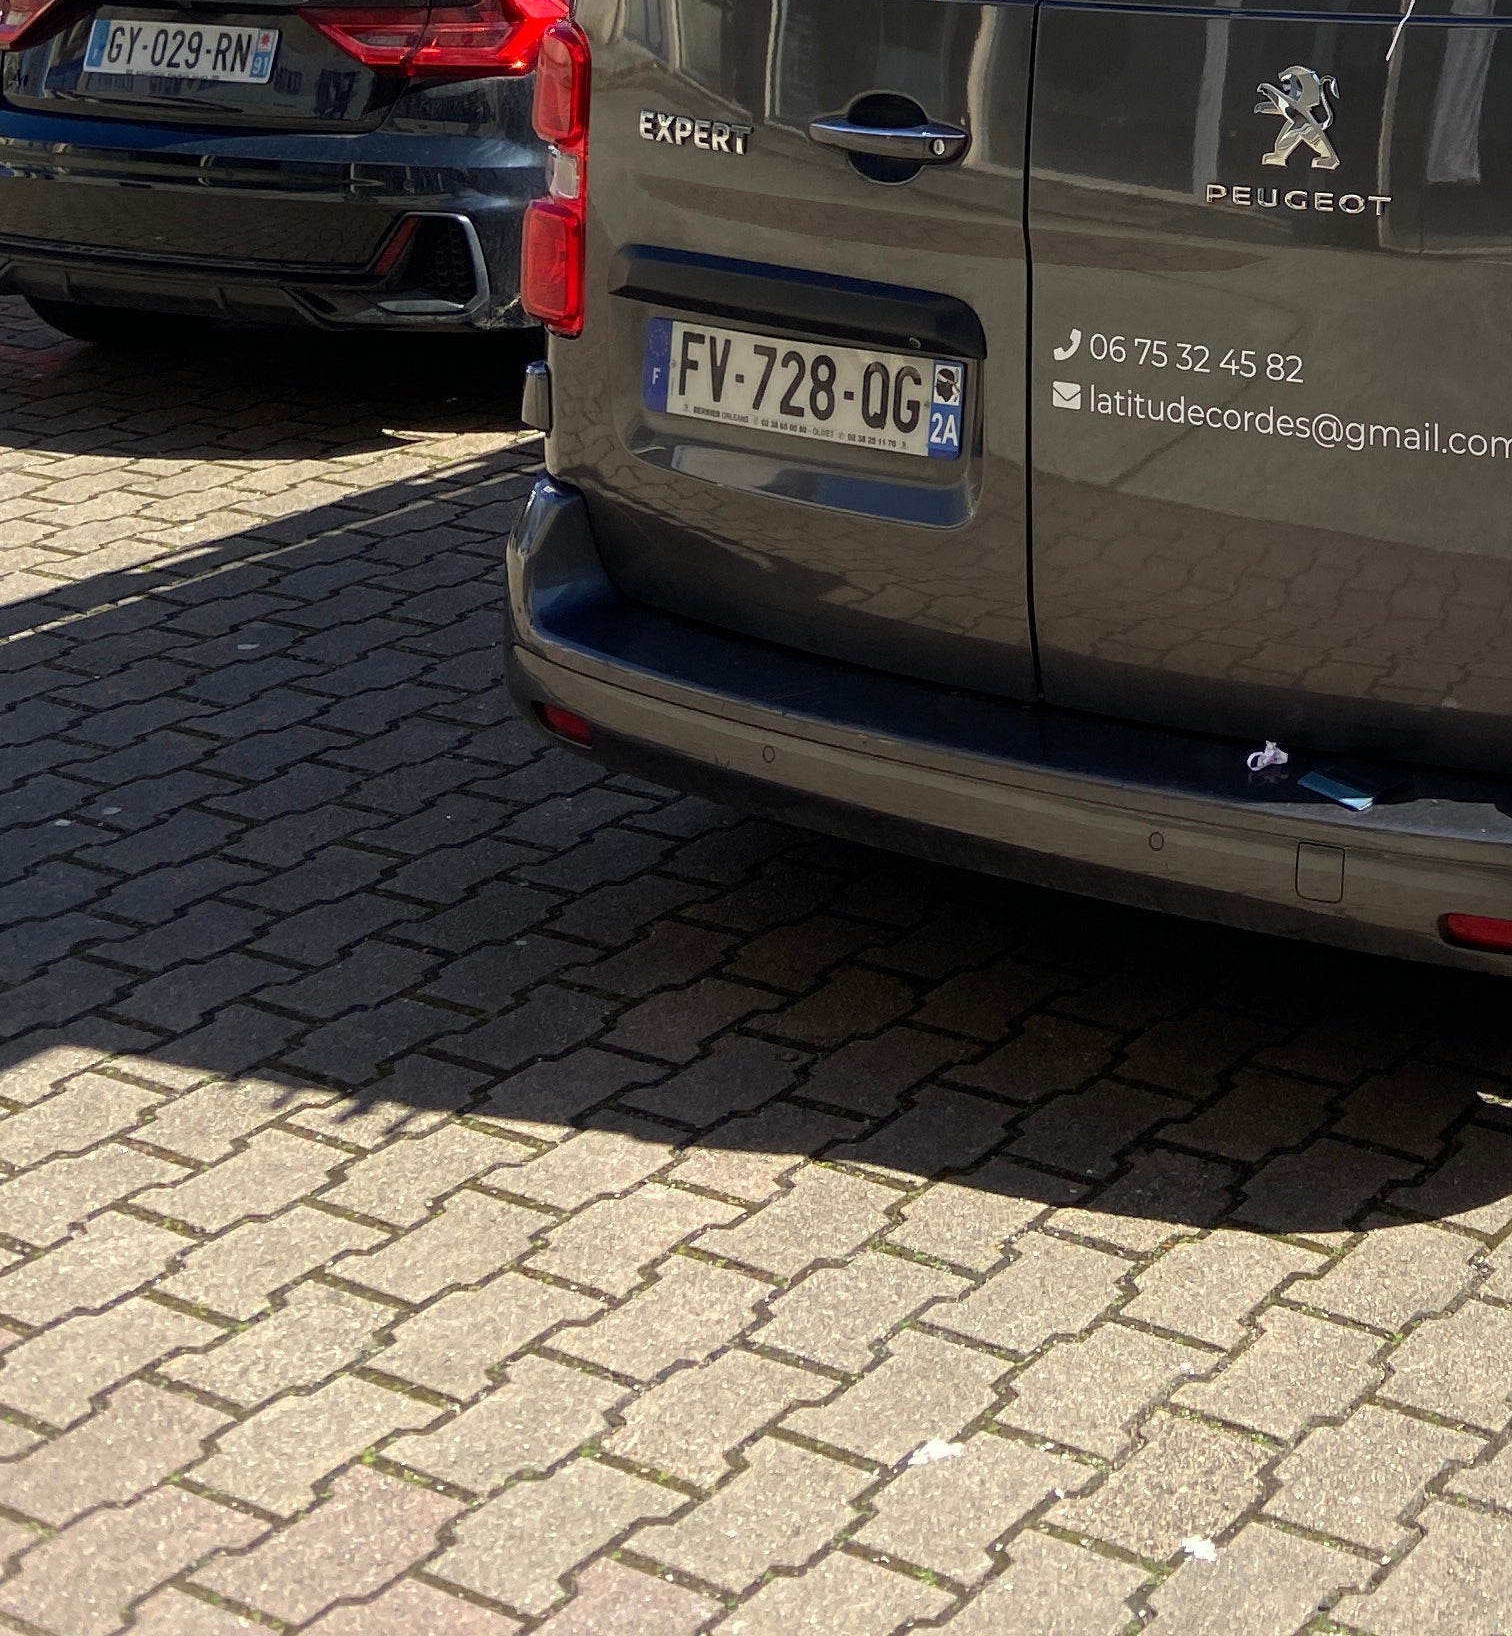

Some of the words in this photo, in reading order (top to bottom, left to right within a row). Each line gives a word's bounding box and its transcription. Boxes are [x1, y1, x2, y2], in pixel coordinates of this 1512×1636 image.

[107, 26, 252, 72] GY-029-RN
[252, 56, 269, 74] 91
[640, 110, 754, 155] EXPERT
[1206, 184, 1392, 216] PEUGEOT
[652, 367, 661, 385] F
[1089, 333, 1127, 363] 06
[1134, 337, 1168, 369] 75
[1176, 343, 1210, 373] 32
[1219, 348, 1257, 378] 45
[1265, 353, 1304, 384] 82
[679, 331, 922, 434] FV-728-QG
[930, 412, 959, 447] 2A
